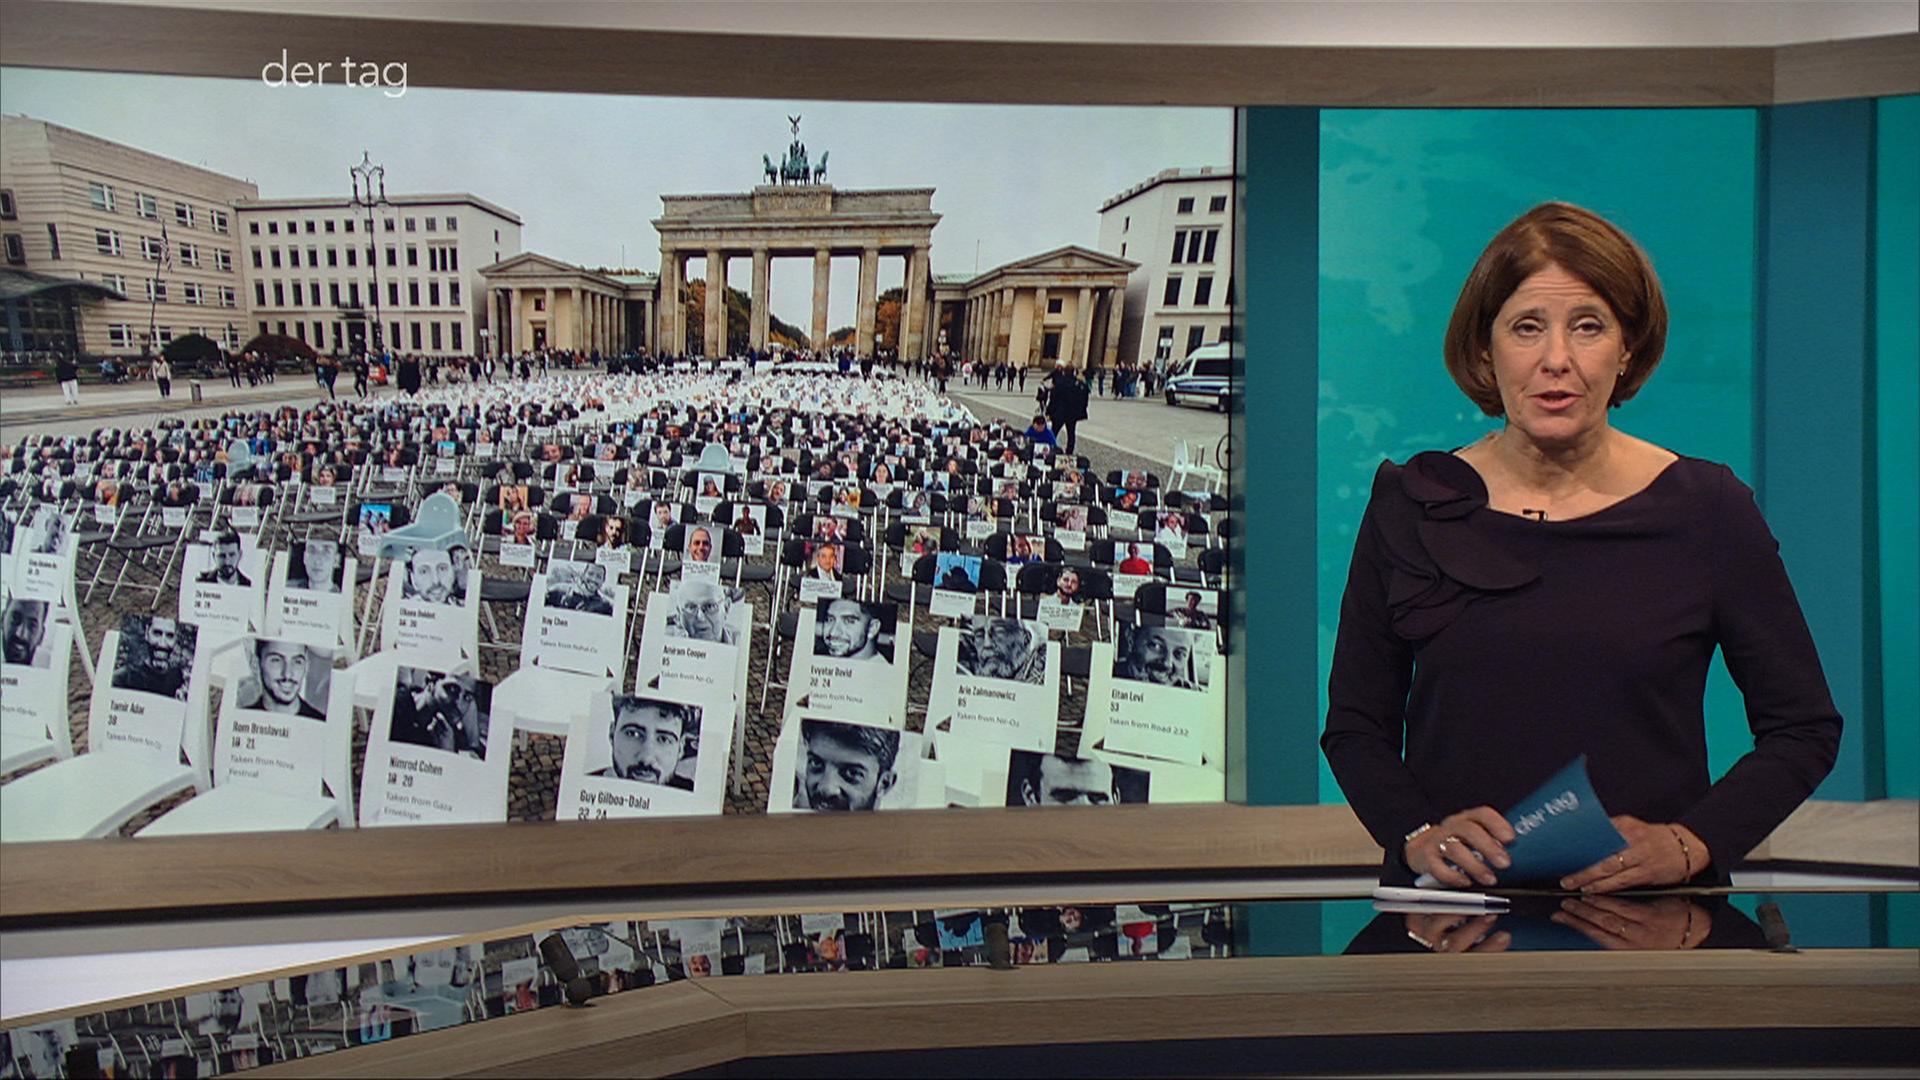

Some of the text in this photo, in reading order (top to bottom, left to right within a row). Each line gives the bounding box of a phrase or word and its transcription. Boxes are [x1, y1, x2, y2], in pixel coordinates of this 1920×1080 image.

[834, 667, 852, 678] David
[1110, 702, 1119, 712] 53
[233, 721, 250, 733] Rom
[1109, 717, 1129, 726] Taken
[1130, 720, 1150, 729] from
[1151, 723, 1172, 733] Road
[246, 738, 255, 750] 21
[231, 754, 295, 770] Taken from Nova
[389, 756, 443, 776] Nimrod Cohen
[402, 774, 413, 787] 20
[386, 791, 453, 812] Taken from Gaza
[580, 789, 650, 810] Guy Gilboa-Dalal
[384, 806, 421, 820] Envelope
[1514, 808, 1546, 835] der
